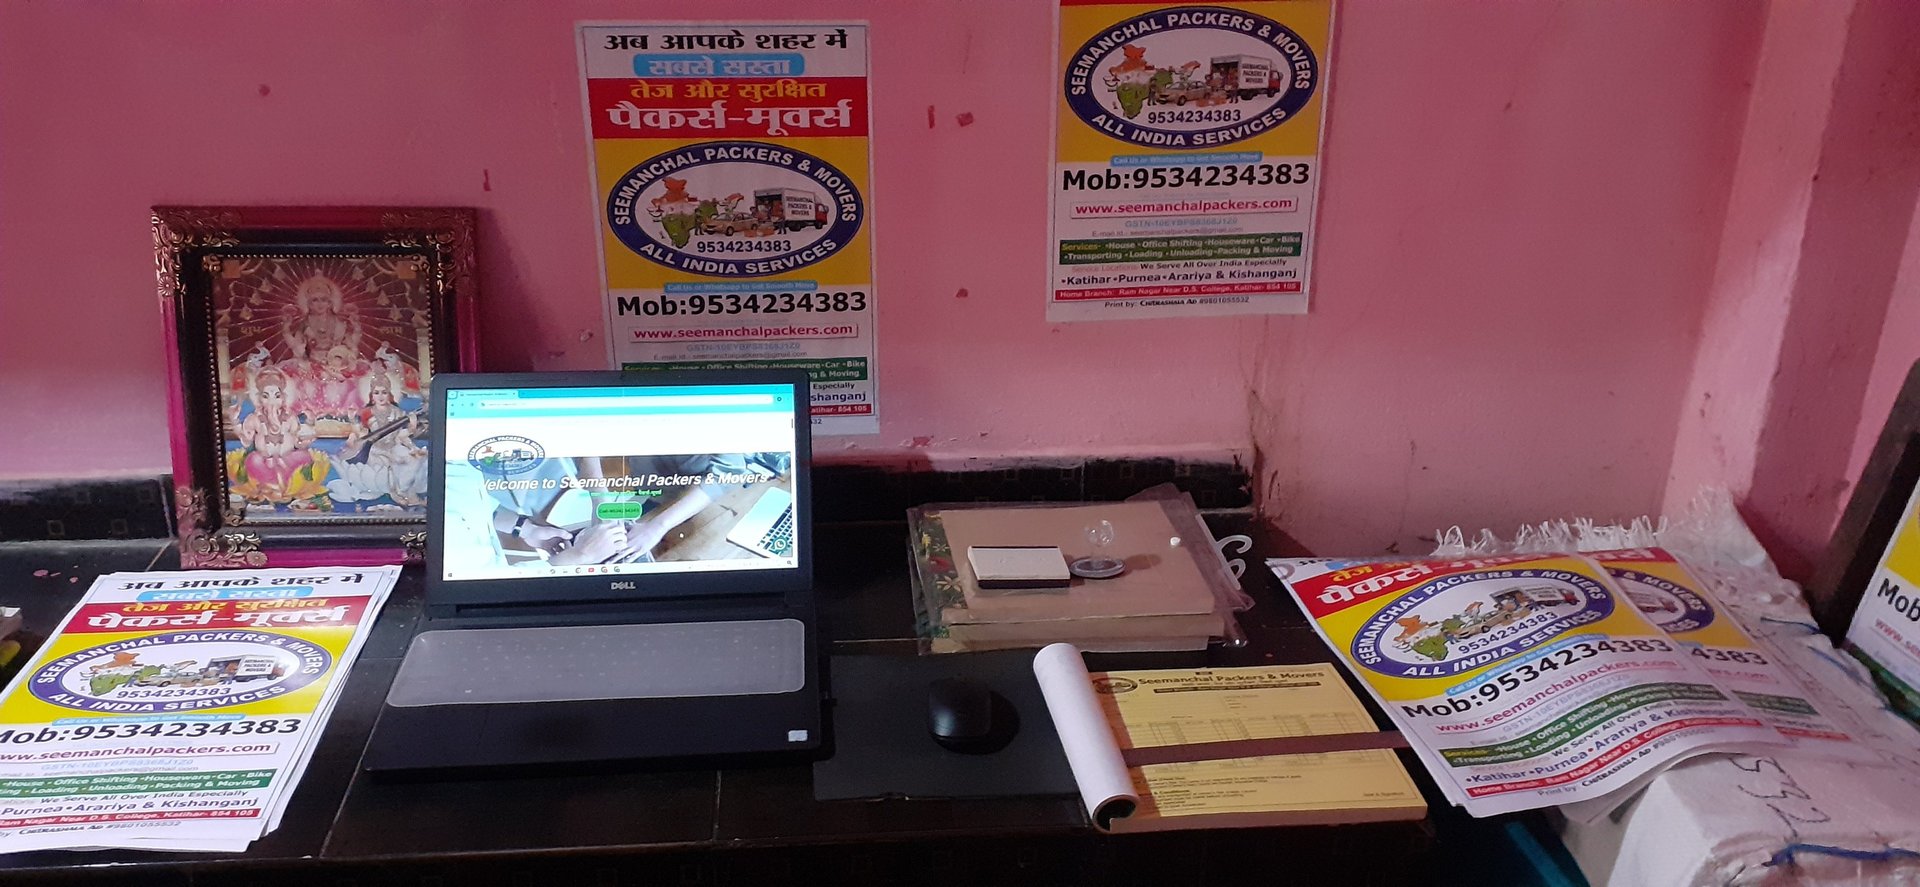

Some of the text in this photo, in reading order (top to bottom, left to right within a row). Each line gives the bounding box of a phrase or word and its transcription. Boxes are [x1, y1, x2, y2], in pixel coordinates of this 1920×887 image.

[604, 29, 848, 50] अब आपके शहर में
[1071, 12, 1310, 95] SEEMANCHAL PACKERS & MOVERS
[648, 56, 790, 75] सबसे सस्ता
[630, 79, 826, 102] तेज और सुरक्षित
[606, 99, 852, 136] पैकर्स-मूवर्स
[1148, 110, 1241, 123] 9534234383
[1092, 108, 1287, 146] ALL INDIA SERVICES
[616, 147, 856, 225] SEEMANCHAL PACKERS & MOVERS
[1062, 164, 1309, 191] Mob:9534234383
[1076, 199, 1292, 214] www.seemanchalpackers.com
[697, 240, 791, 252] 9534234383
[640, 240, 836, 274] ALL INDIA SERVICES
[1245, 259, 1287, 267] Especially
[1067, 275, 1111, 285] Katihar
[1216, 271, 1224, 279] &
[1229, 268, 1297, 280] Kishanganj
[1139, 287, 1161, 295] Nagar
[618, 291, 866, 316] Mob:9534234383
[634, 324, 853, 339] www.seemanchalpackers.com
[825, 359, 865, 369] Car Bike
[829, 370, 860, 379] Moving
[813, 382, 855, 391] Especially
[542, 478, 556, 489] to
[560, 474, 645, 489] Seemanchal
[648, 473, 701, 487] Packers
[704, 474, 715, 485] &
[718, 471, 769, 485] Movers
[117, 573, 366, 591] अब आपके शहर में
[611, 581, 636, 590] DELL
[1643, 576, 1706, 610] MOVERS
[122, 600, 168, 612] तेज
[177, 600, 226, 612] और
[1359, 594, 1424, 665] SEEMANCHAL
[1423, 571, 1512, 595] PACKERS
[1541, 571, 1606, 600] MOVERS
[1458, 611, 1557, 653] 9534234383
[1403, 610, 1602, 676] ALL INDIA SERVICES
[37, 631, 319, 684] SEEMANCHAL PACKERS & MOVERS
[1138, 674, 1213, 685] Seemanchal
[1216, 673, 1265, 683] Packers
[1279, 669, 1325, 679] Movers
[1400, 639, 1673, 718] Mob:9534234383
[48, 686, 286, 713] ALL INDIA SERVICES
[117, 686, 231, 699] 9534234383
[1602, 720, 1616, 732] All
[1617, 709, 1640, 723] Over
[1471, 770, 1526, 783] Katihar
[1594, 718, 1647, 751] Arariya
[1650, 713, 1663, 722] &
[73, 801, 137, 812] Arariya
[161, 797, 259, 809] Kishanganj
[120, 793, 149, 801] Over
[152, 791, 184, 799] India
[188, 790, 248, 799] Especially
